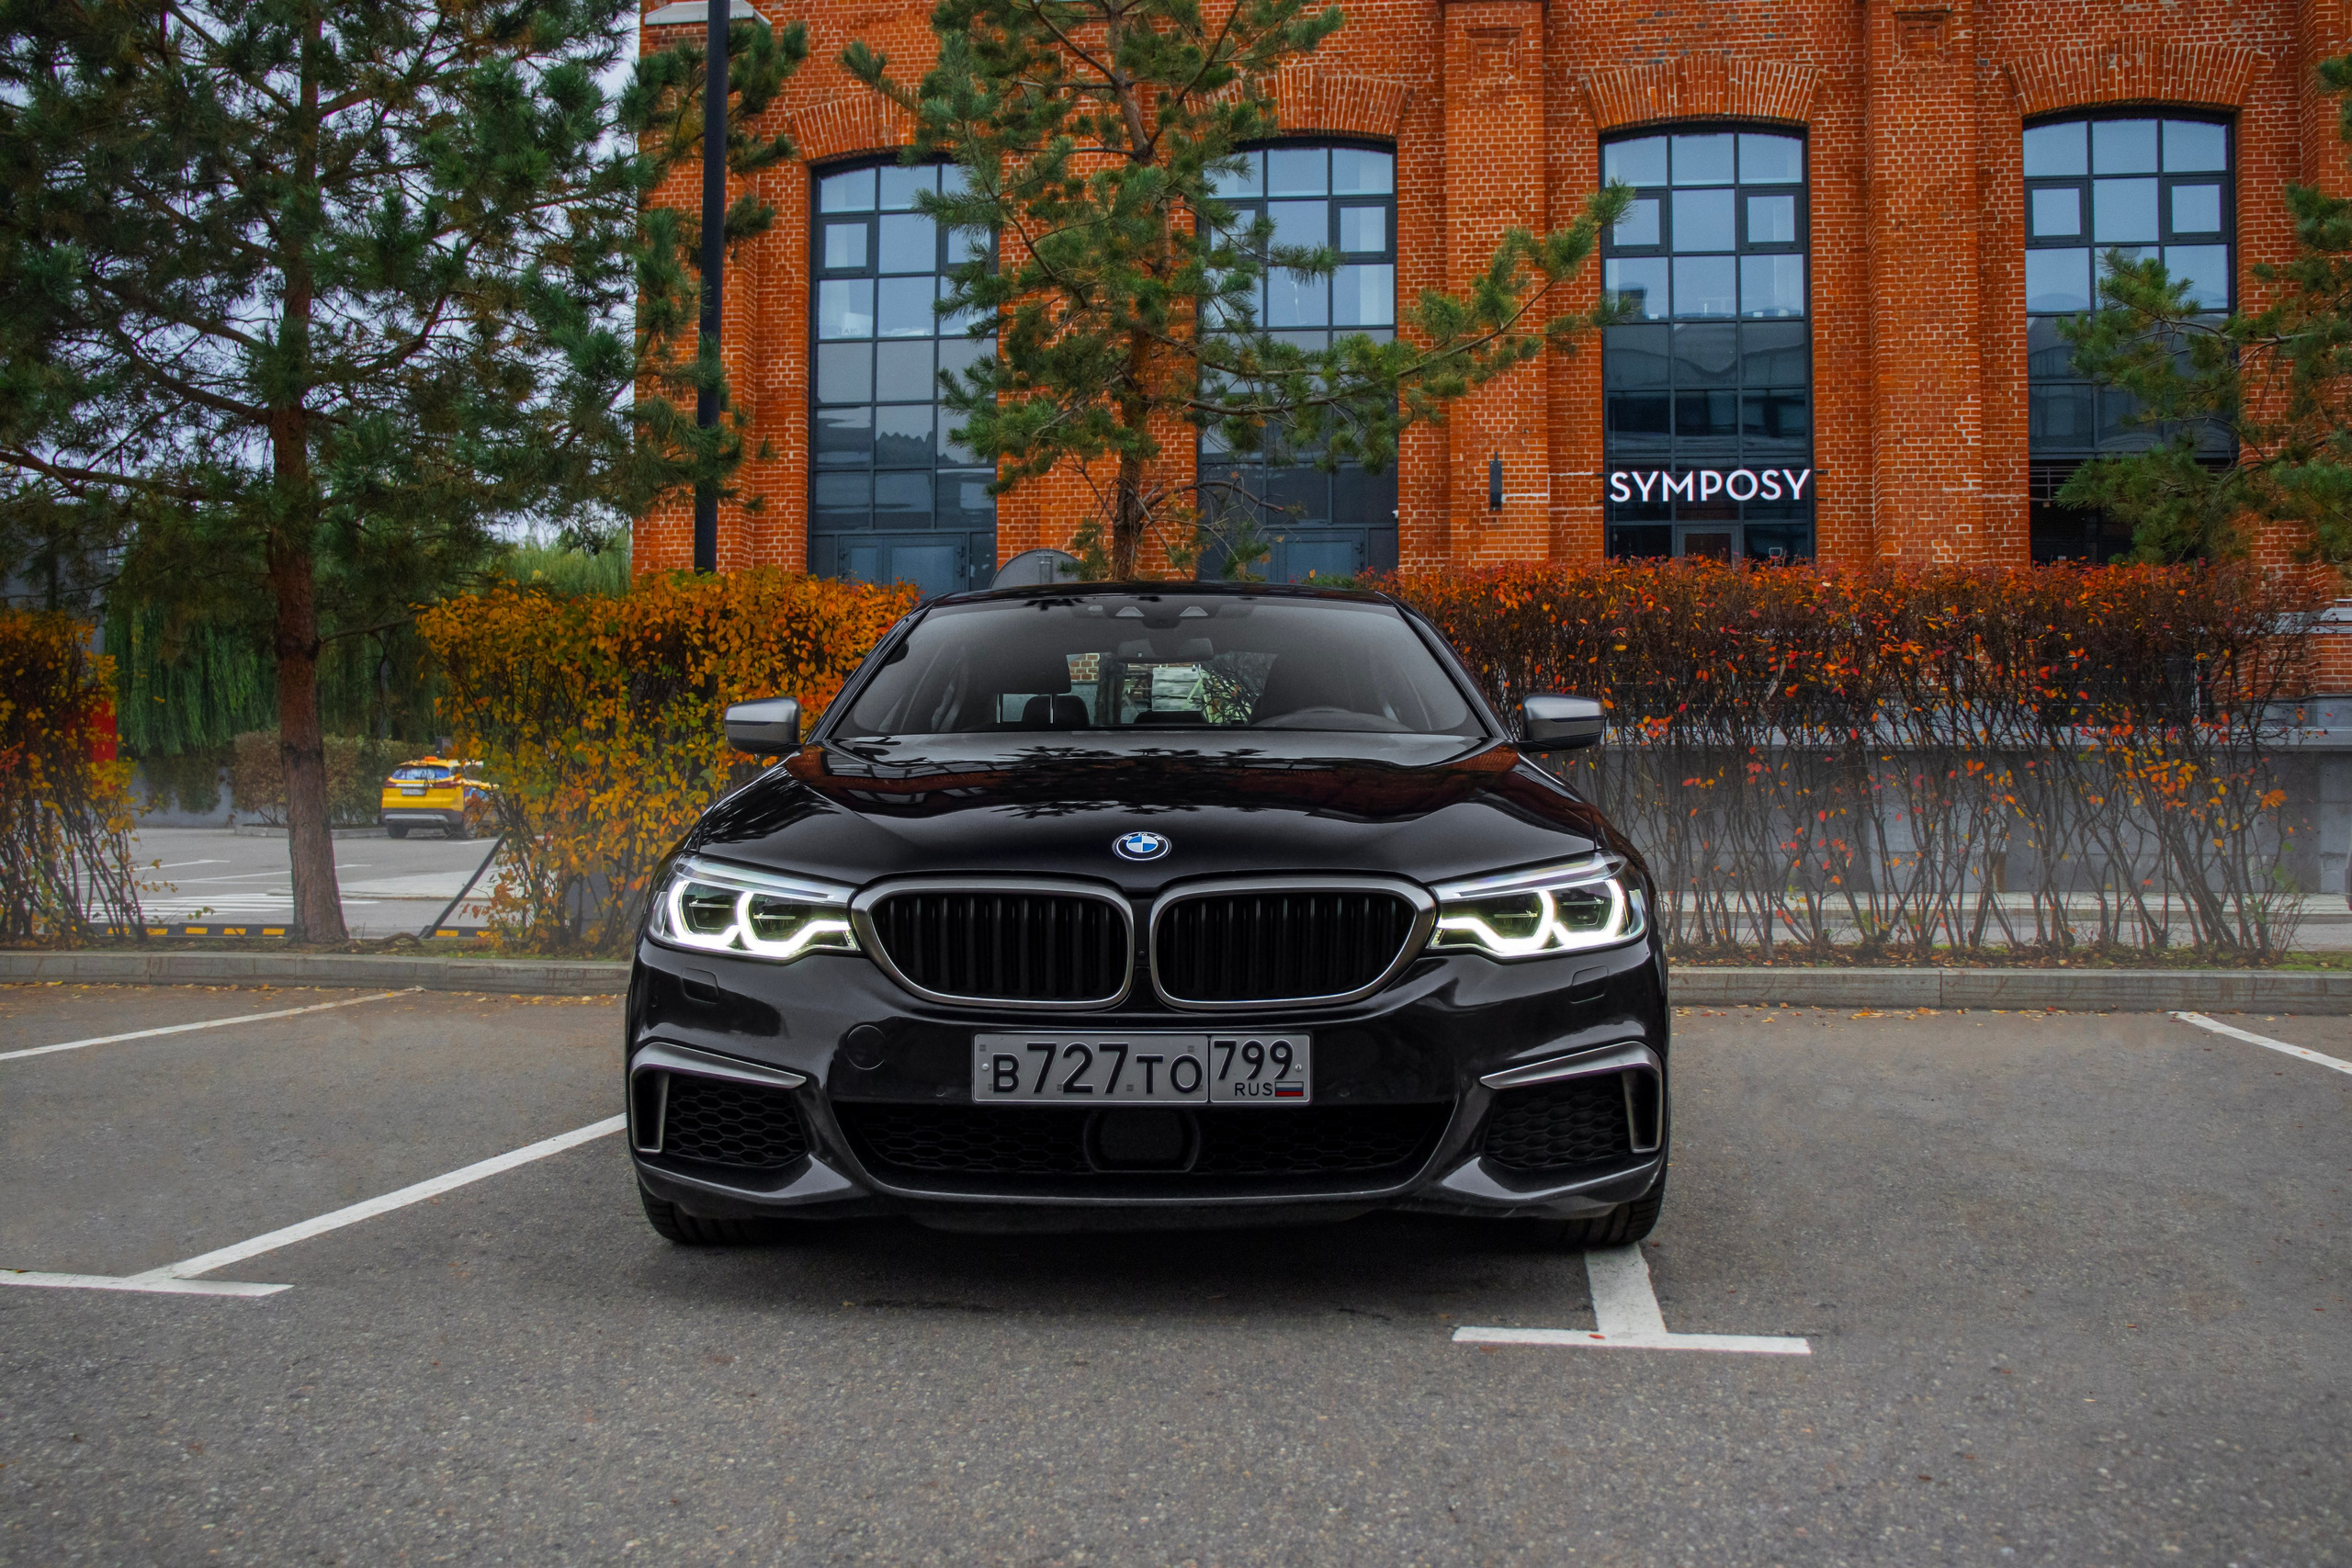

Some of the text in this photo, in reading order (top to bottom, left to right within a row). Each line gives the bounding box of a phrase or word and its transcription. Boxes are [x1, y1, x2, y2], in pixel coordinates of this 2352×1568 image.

[1609, 468, 1811, 502] SYMPOSY
[1213, 1038, 1295, 1081] 799
[1234, 1081, 1273, 1097] RUS
